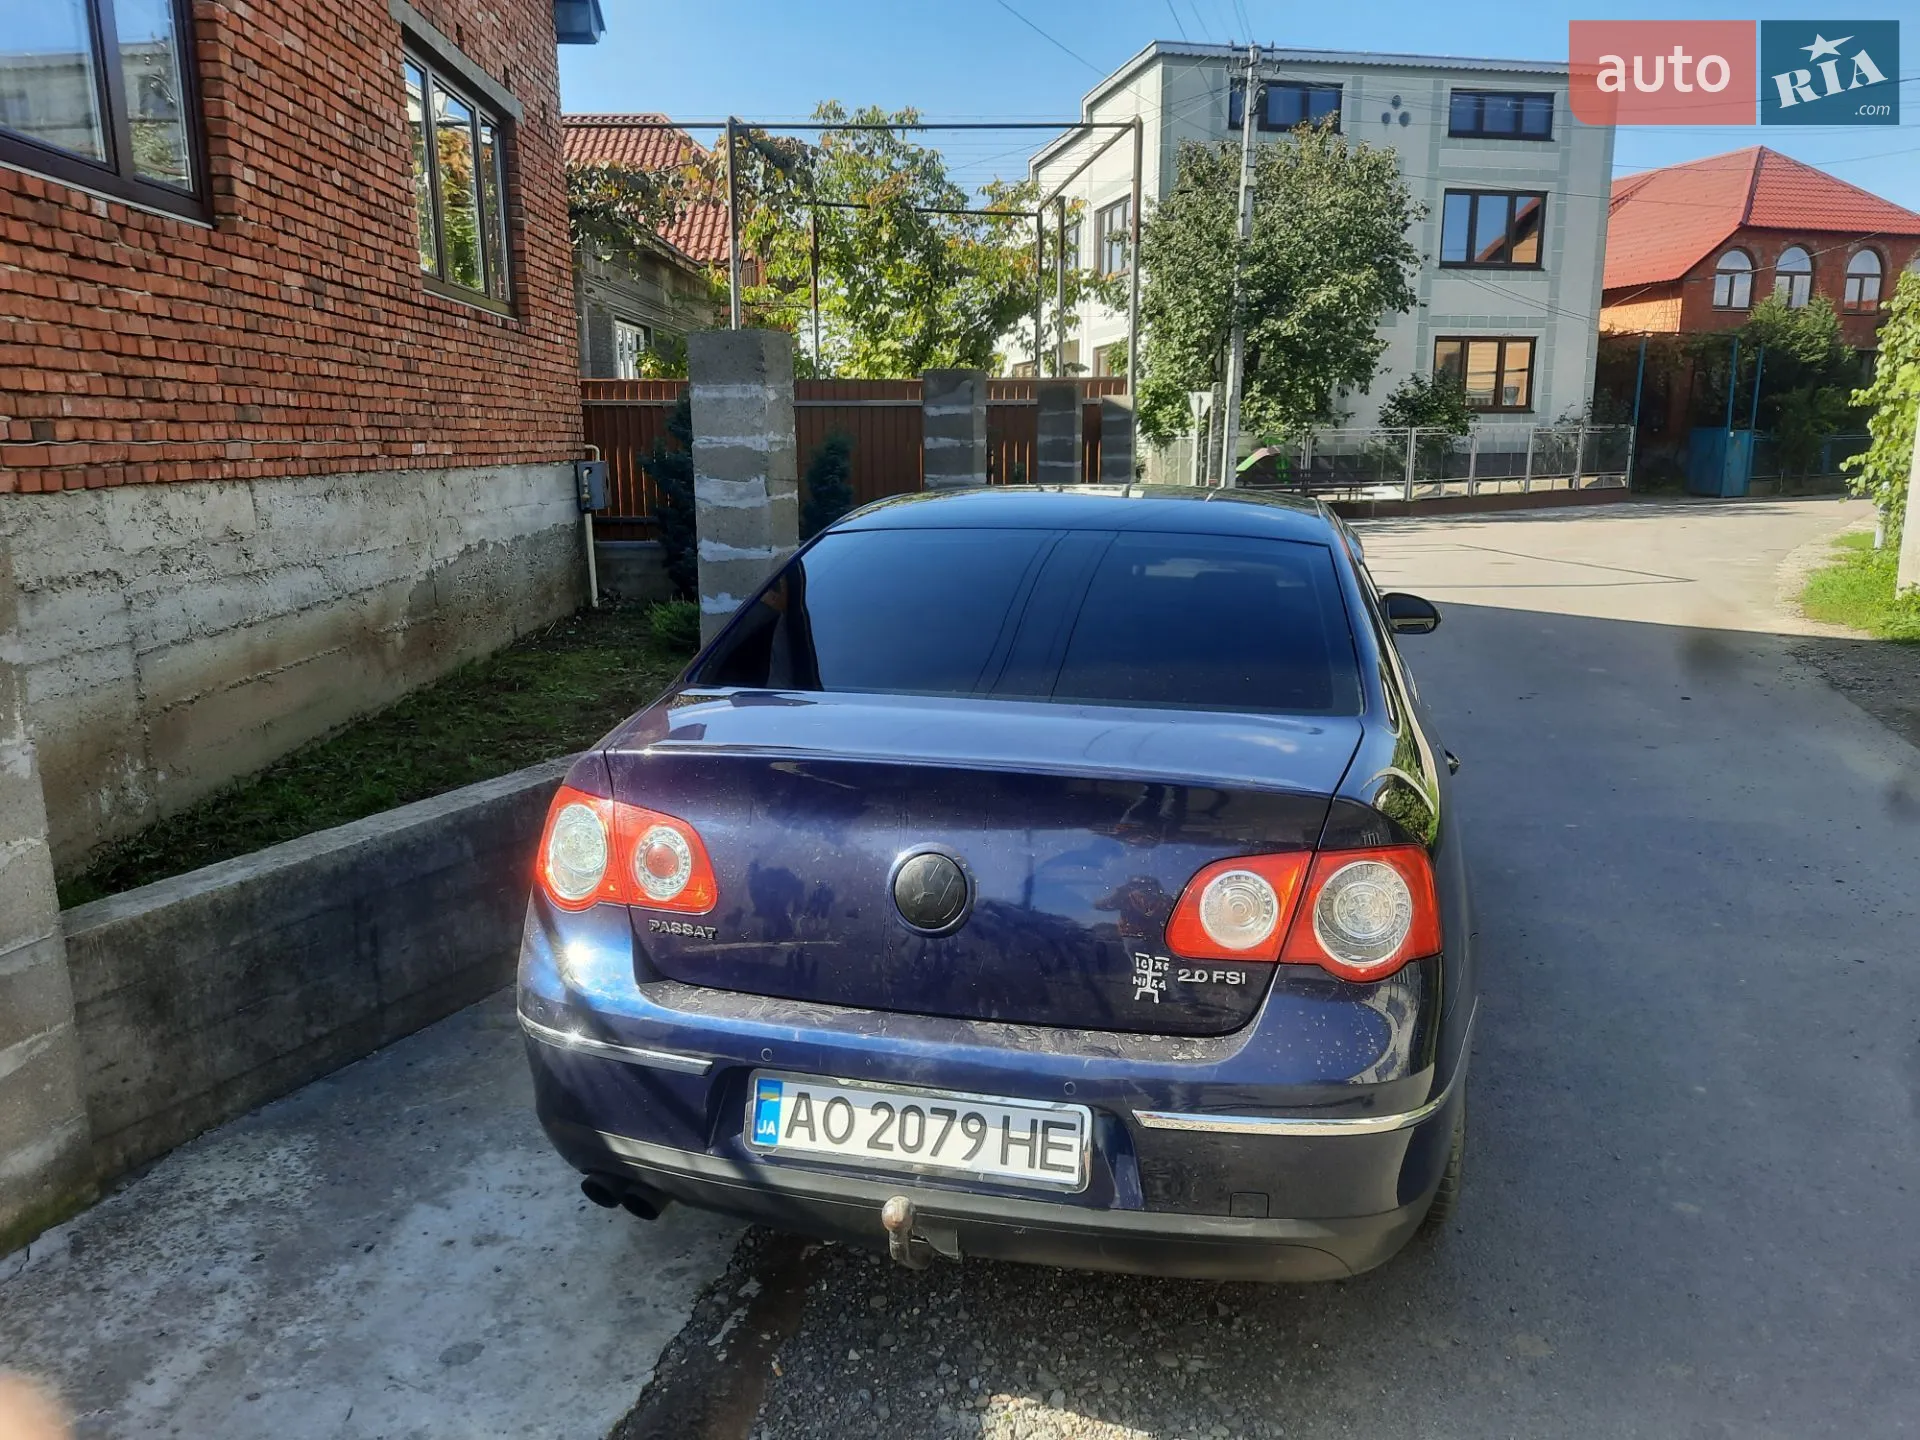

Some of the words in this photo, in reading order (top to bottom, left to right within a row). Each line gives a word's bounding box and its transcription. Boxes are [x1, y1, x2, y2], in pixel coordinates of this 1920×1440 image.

[648, 919, 717, 940] PASSAT
[1212, 970, 1246, 985] FSI
[785, 1091, 855, 1145] AO
[867, 1101, 987, 1161] 2079
[1000, 1115, 1077, 1174] HE
